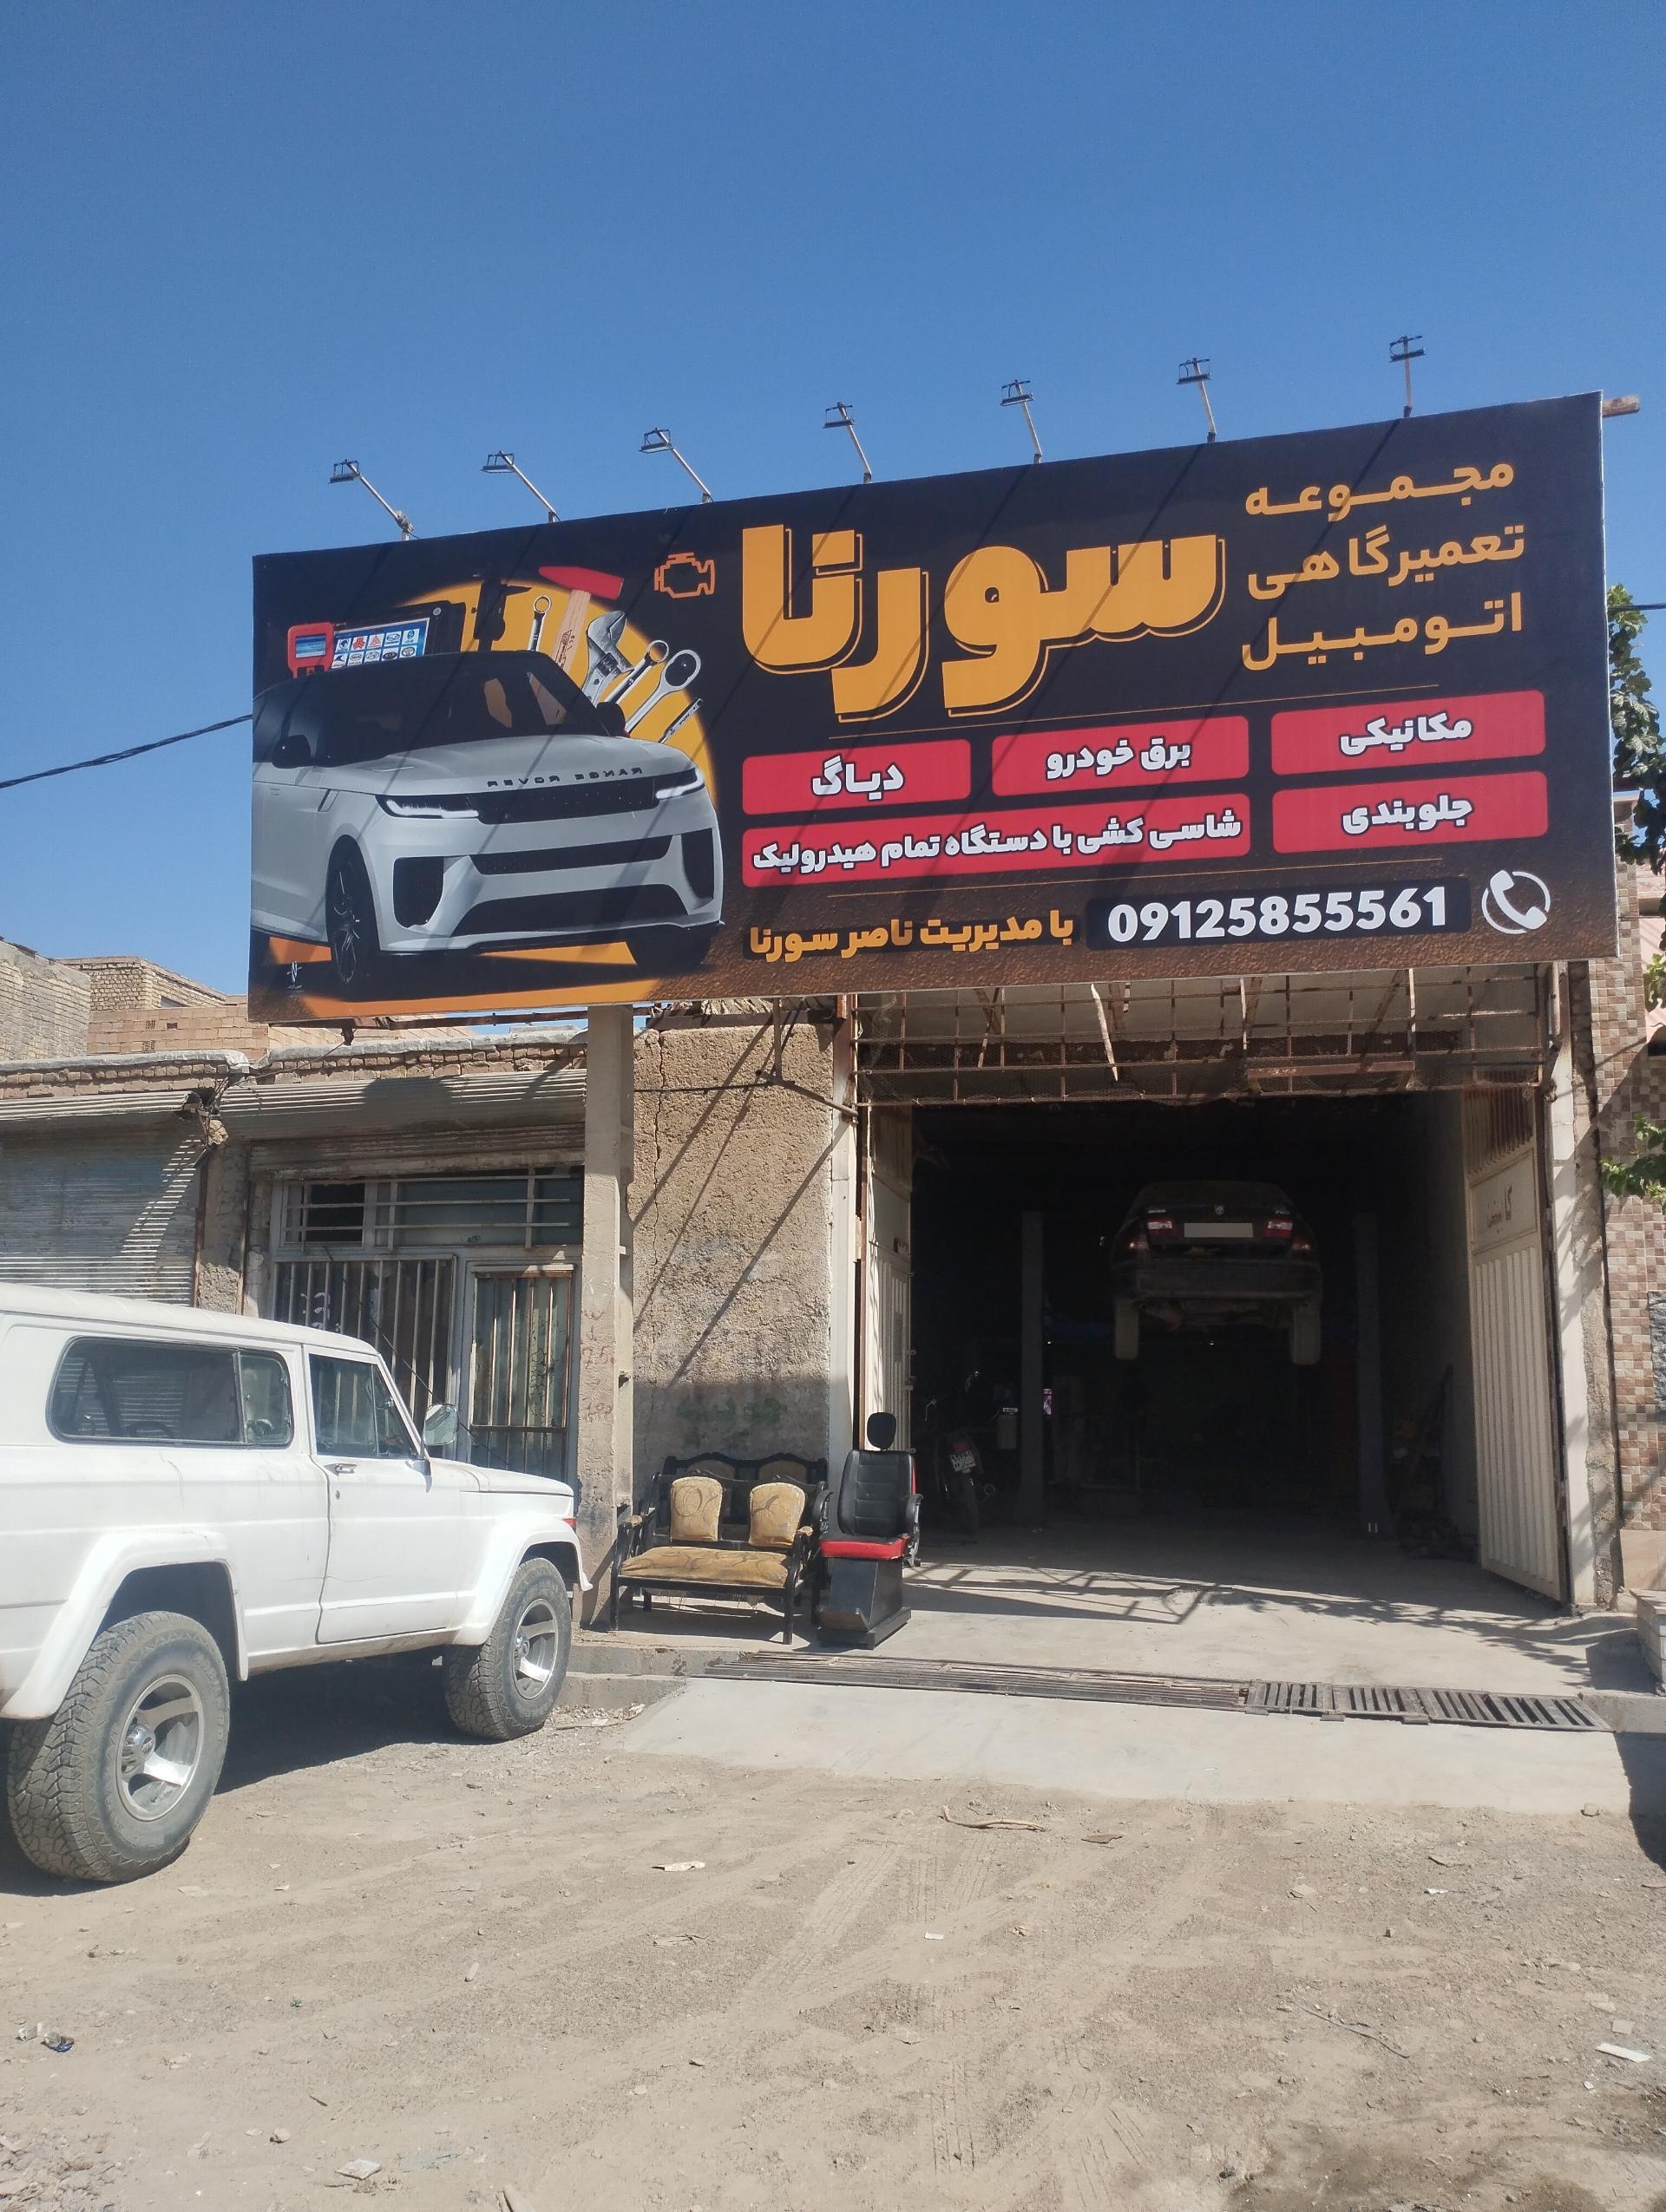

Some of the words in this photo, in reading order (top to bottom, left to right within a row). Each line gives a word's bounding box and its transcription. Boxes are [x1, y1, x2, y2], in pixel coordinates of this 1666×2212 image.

[1245, 462, 1514, 522] مجموعه
[742, 524, 1226, 723] سورنا
[1242, 592, 1522, 671] اتومبیل
[1141, 736, 1191, 771] برق
[1340, 711, 1473, 756] مکانیکی
[811, 754, 905, 801] دیاگ
[1046, 738, 1135, 780] خودرو
[1148, 808, 1242, 850] شاسی
[1341, 794, 1473, 835] جلوبندی
[880, 834, 941, 867] تمام
[944, 823, 1047, 855] دستگاه
[1052, 824, 1072, 854] با
[1077, 816, 1145, 855] کشی
[752, 841, 877, 874] هیدرولیک
[919, 915, 1043, 953] مدیریت
[1049, 908, 1074, 946] با
[1107, 885, 1446, 943] 09125855561
[750, 926, 839, 964] سورنا
[840, 918, 914, 959] ناصر
